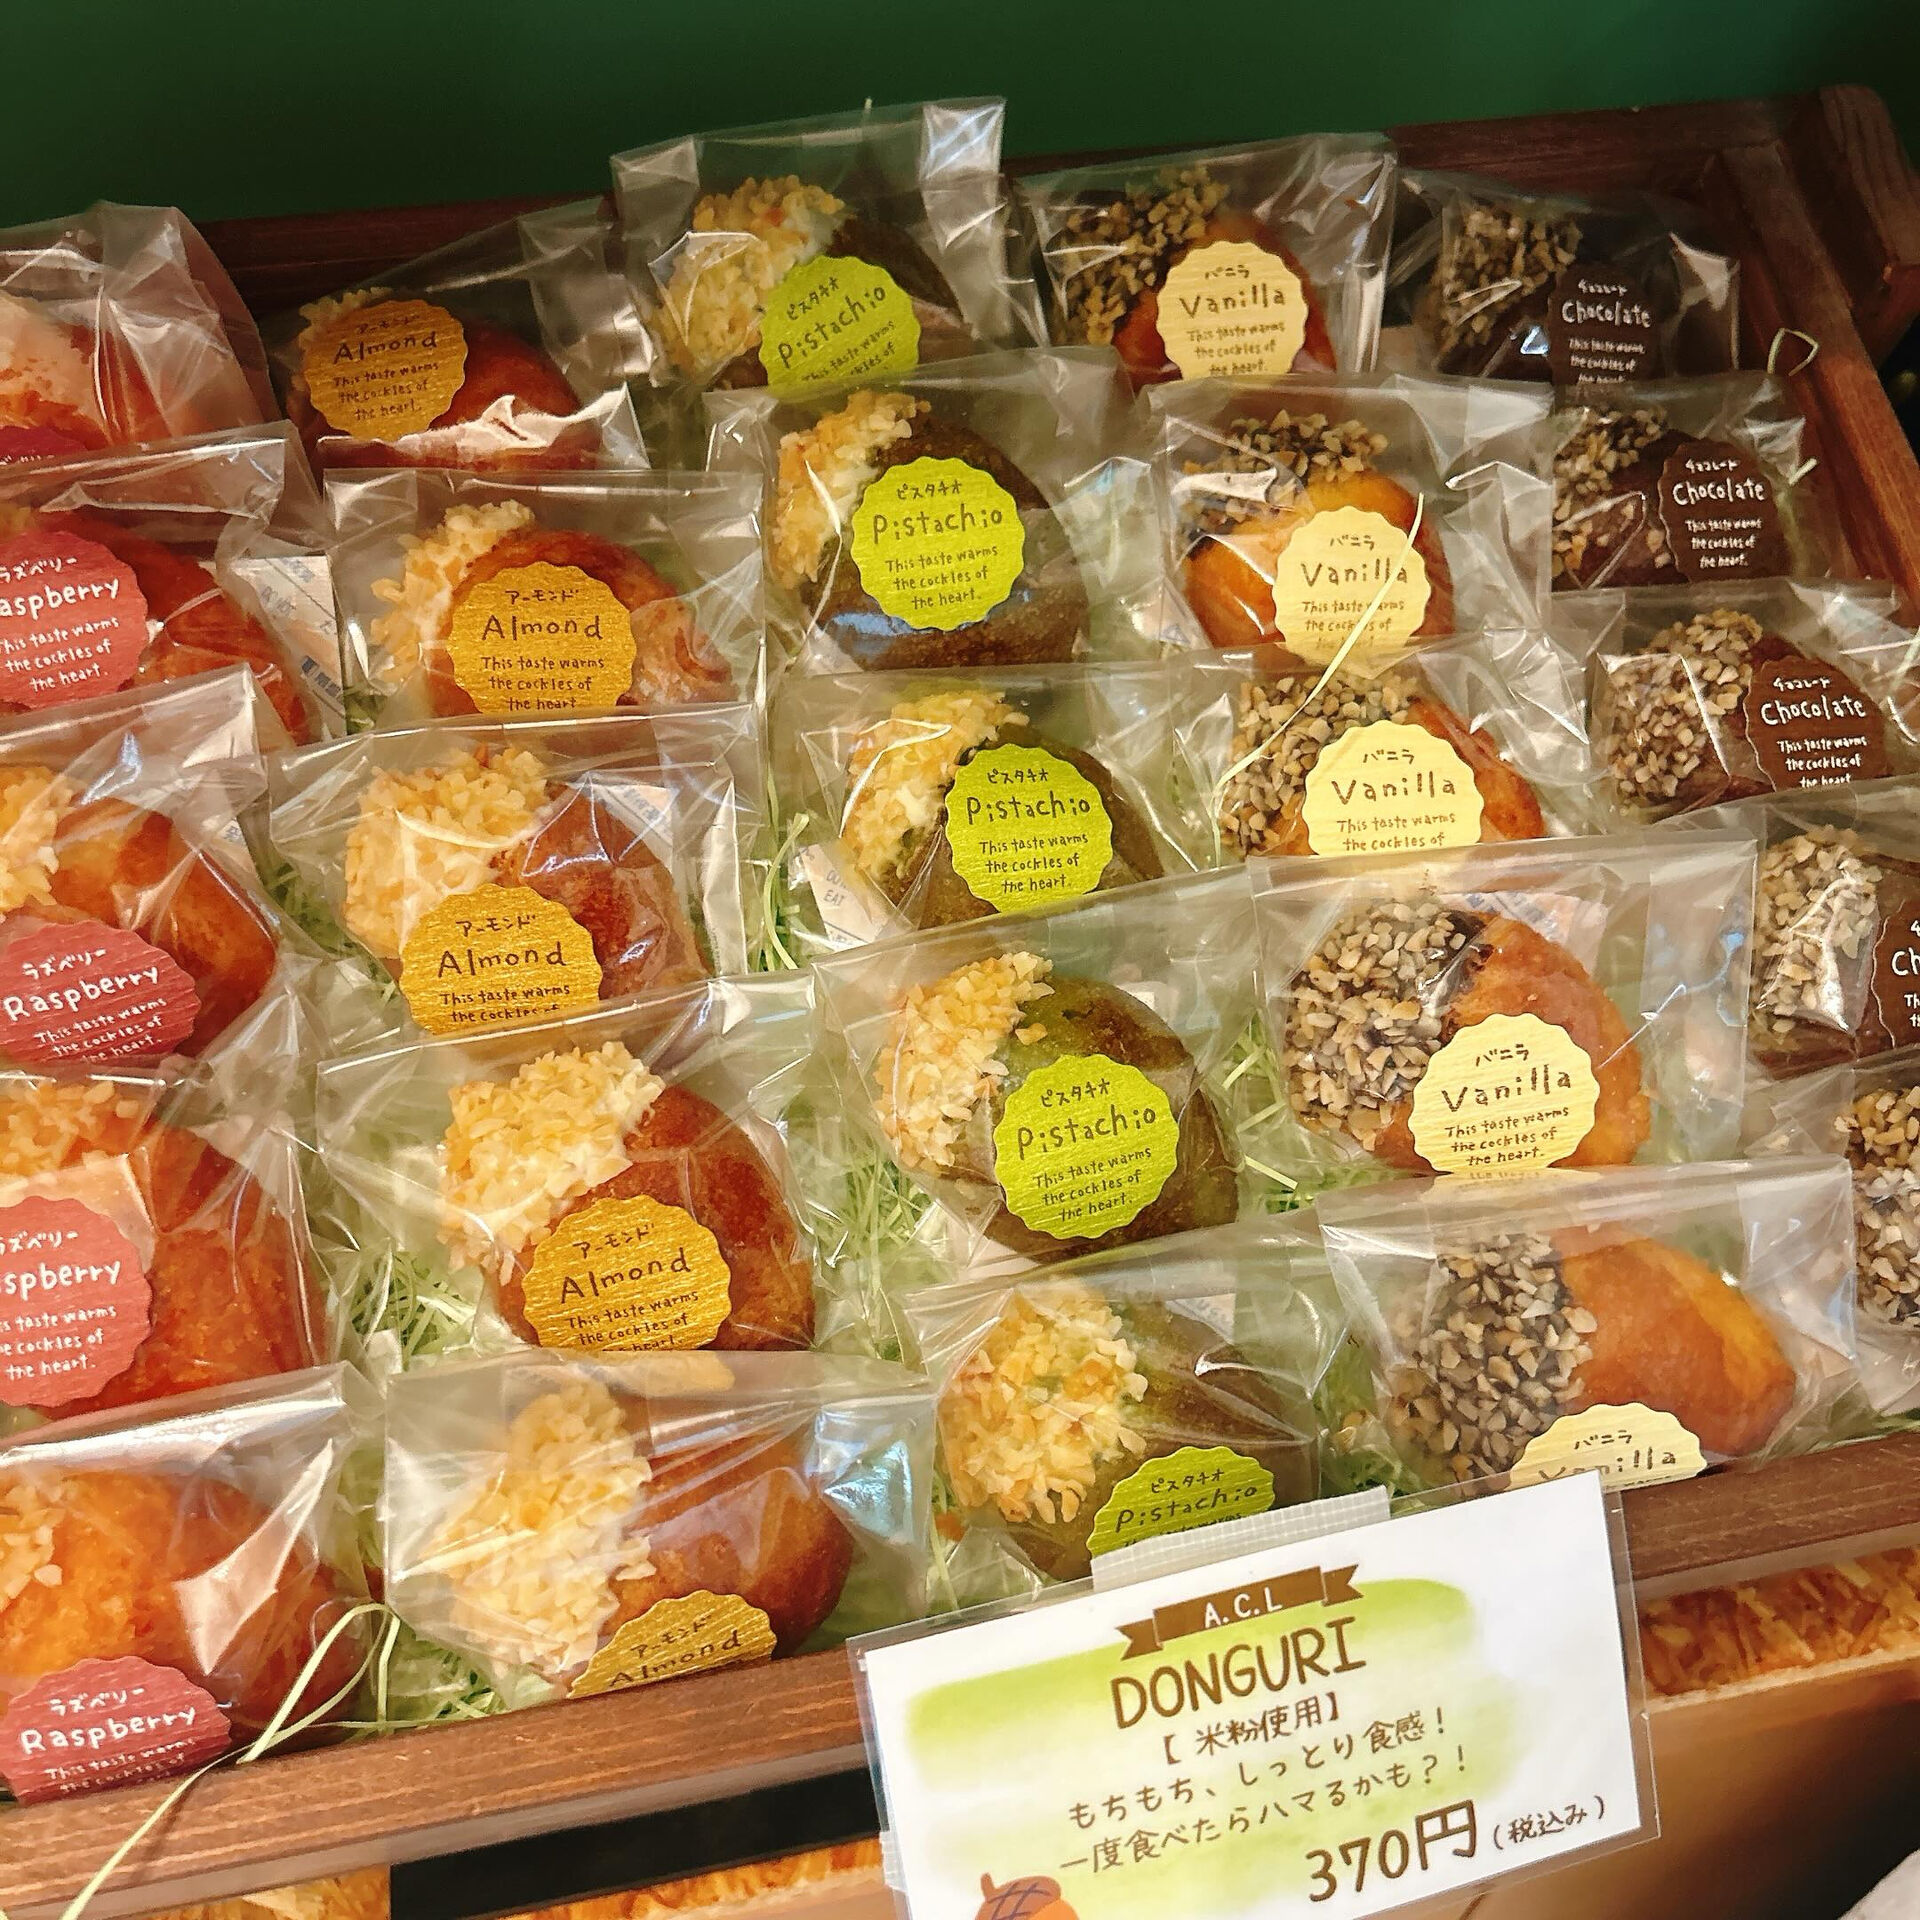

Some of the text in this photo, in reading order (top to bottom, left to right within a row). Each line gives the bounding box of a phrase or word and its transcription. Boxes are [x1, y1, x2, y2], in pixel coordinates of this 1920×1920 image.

[1205, 264, 1249, 278] バニラ
[787, 276, 839, 320] ピスタチオ
[1179, 283, 1285, 318] Vanilla
[358, 315, 420, 334] アーモンド
[778, 287, 886, 368] Pistachio
[1562, 300, 1651, 328] Chocolate
[333, 331, 437, 364] Almond
[830, 320, 896, 369] taste warms
[333, 363, 439, 388] This taste warms
[1685, 459, 1738, 473] チョコレート
[897, 479, 962, 499] ピスタチオ
[1673, 477, 1764, 505] Chocolate
[873, 503, 1003, 544] Pistachio
[1330, 535, 1375, 550] バニラ
[885, 546, 998, 573] This taste warms
[1301, 558, 1408, 587] Vanilla
[893, 566, 988, 591] the cockles of
[0, 578, 119, 620] aspberry
[505, 589, 579, 605] アーモンド
[912, 588, 981, 609] the heart.
[1302, 600, 1363, 613] This taste
[0, 617, 119, 655] his taste warms
[482, 615, 603, 640] Almond
[1305, 618, 1392, 631] the of
[6, 638, 111, 674] the cockles of
[480, 656, 604, 671] This taste warms
[30, 664, 108, 692] the heart.
[488, 676, 592, 690] the cockles of
[1773, 677, 1830, 691] チョコレート
[506, 698, 531, 711] the
[1761, 695, 1866, 725] Chocolate
[1363, 749, 1414, 765] バニラ
[1776, 736, 1867, 754] This taste warms
[987, 768, 1048, 784] ピスタチオ
[1785, 754, 1861, 771] the cockles of
[1331, 770, 1456, 805] Vanilla
[1800, 776, 1817, 788] the
[967, 790, 1091, 825] Pistachio
[1336, 813, 1456, 834] This taste warms
[980, 834, 1088, 855] This taste warms
[1343, 832, 1444, 851] the cockles of
[986, 853, 1079, 873] the cockles of
[1002, 880, 1024, 894] the
[456, 914, 536, 937] アーモンド
[22, 949, 106, 980] ラズベリー
[438, 941, 567, 978] Almond
[3, 966, 158, 1022] Raspberry
[439, 985, 570, 1006] This taste warms
[34, 998, 167, 1044] This taste warms
[450, 1011, 475, 1023] the
[52, 1015, 162, 1057] the cockles of
[113, 1034, 162, 1056] heart.
[1475, 1044, 1529, 1066] バニラ
[1041, 1078, 1110, 1107] ピスタチオ
[1442, 1064, 1571, 1112] Vanilla
[1017, 1104, 1156, 1160] Pistachio
[1445, 1107, 1569, 1138] This taste warms
[1451, 1127, 1558, 1152] the cockles of
[1033, 1148, 1152, 1188] This taste warms
[1466, 1147, 1545, 1166] the heart.
[1042, 1169, 1142, 1205] the cockles of
[1059, 1193, 1132, 1221] the heart.
[573, 1224, 654, 1259] アーモンド
[0, 1260, 120, 1301] spberry
[561, 1247, 691, 1304] Almond
[16, 1313, 58, 1331] taste
[62, 1305, 116, 1323] warms
[569, 1291, 699, 1330] This taste warms
[17, 1336, 82, 1354] cockles
[87, 1328, 103, 1344] of
[579, 1312, 688, 1346] the cockles of
[6, 1353, 96, 1380] the heart.
[1574, 1430, 1632, 1450] バニラ
[1151, 1468, 1224, 1493] ピスタチオ
[1115, 1487, 1258, 1533] Pistachio
[1204, 1587, 1283, 1628] A.C.L
[630, 1614, 712, 1658] アーモンド
[610, 1629, 742, 1687] Almond
[1111, 1616, 1366, 1729] DONGURI
[50, 1688, 144, 1716] ラズベリー
[20, 1706, 195, 1755] Raspberry
[44, 1738, 195, 1779] This taste warms
[1305, 1799, 1477, 1902] 370円
